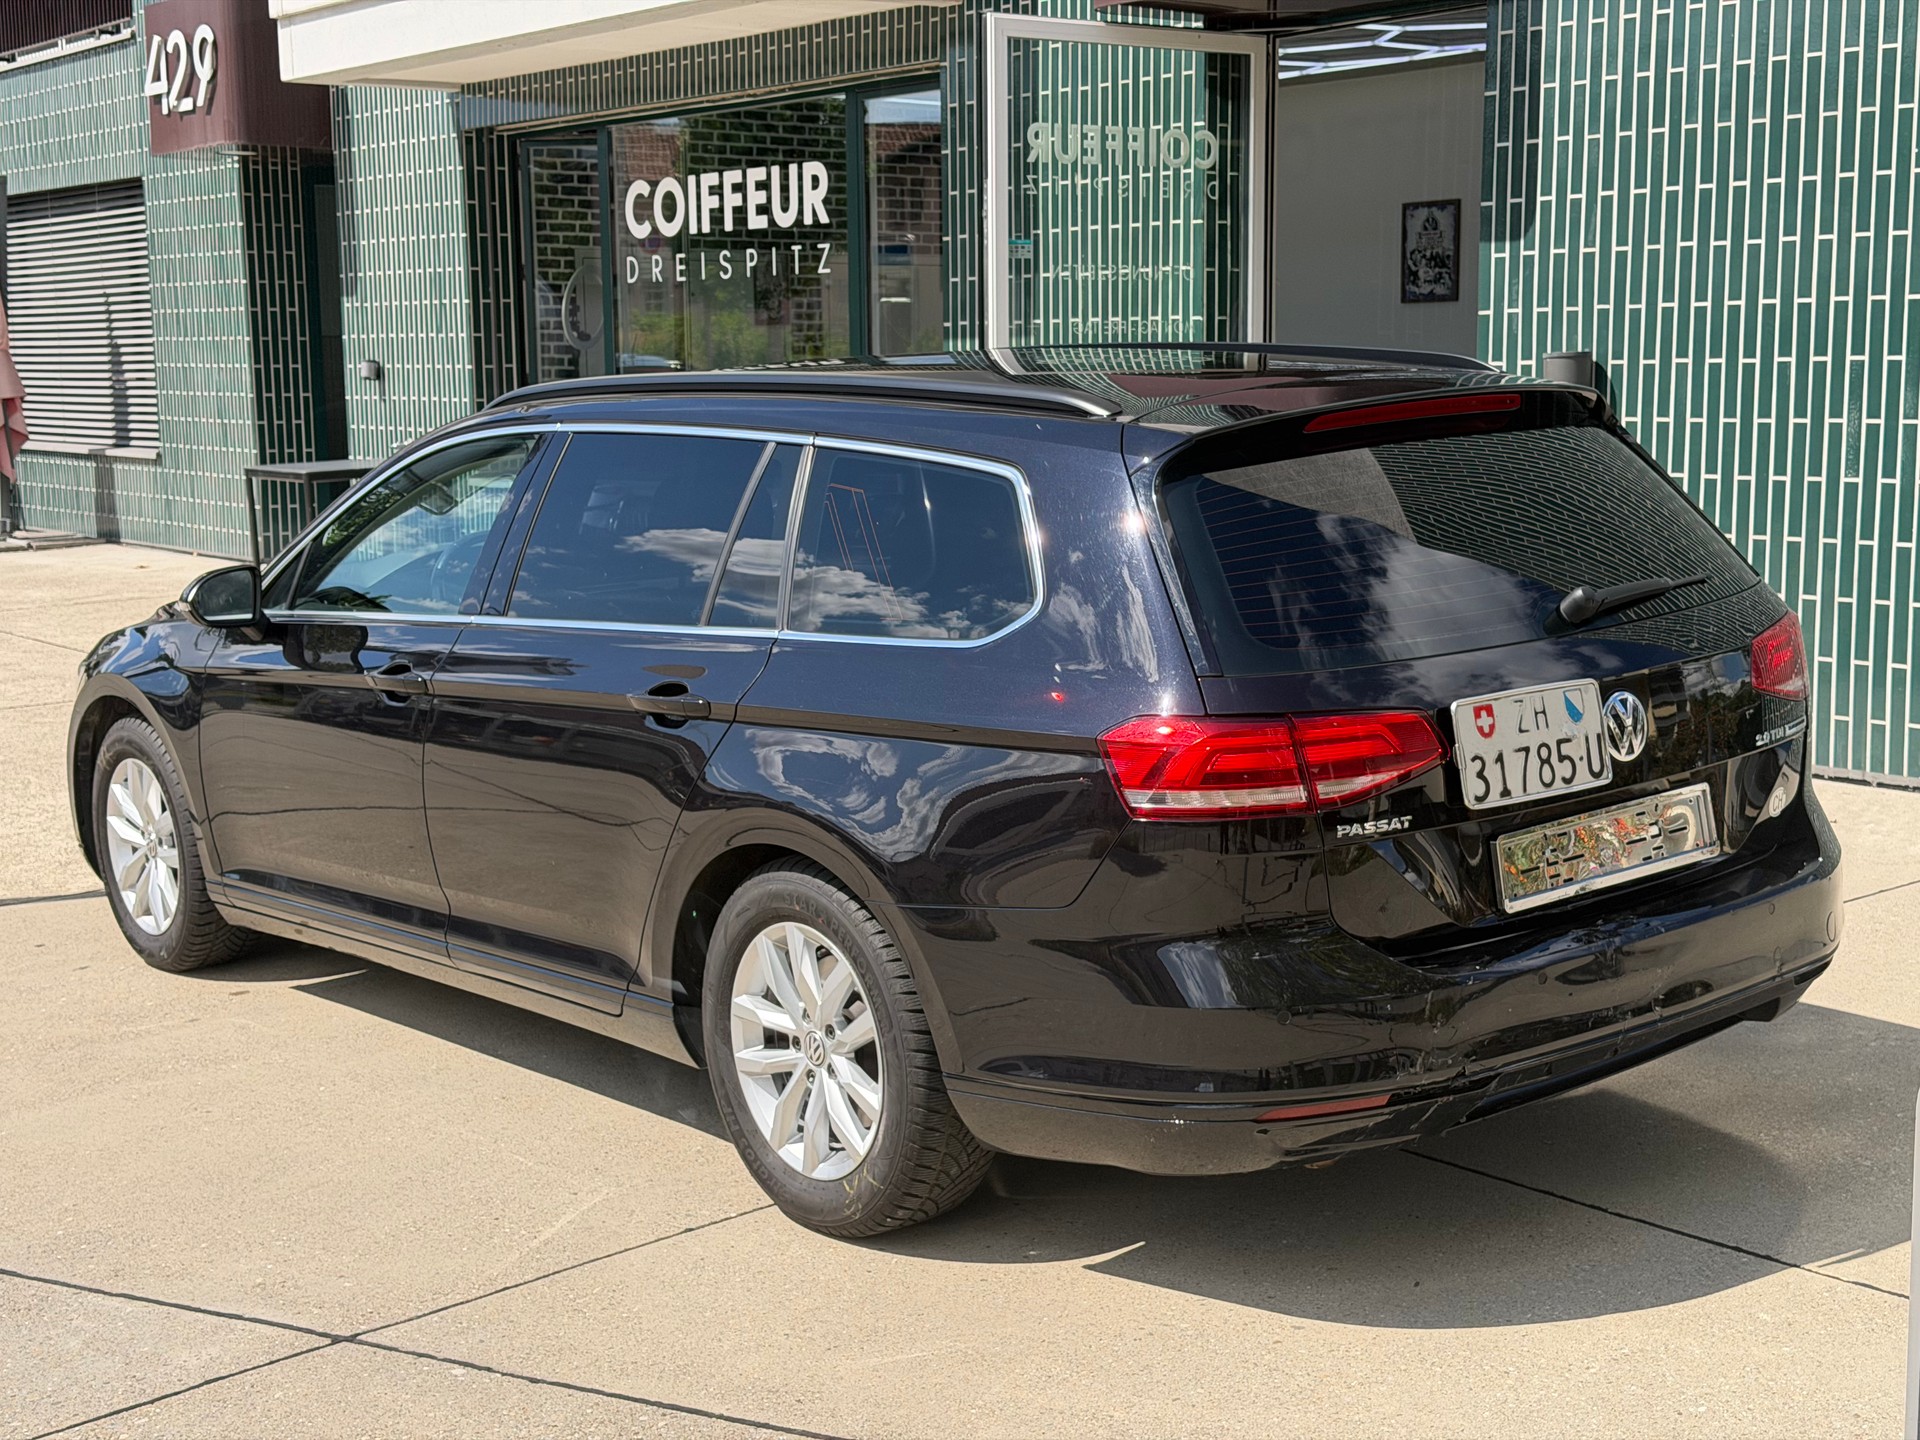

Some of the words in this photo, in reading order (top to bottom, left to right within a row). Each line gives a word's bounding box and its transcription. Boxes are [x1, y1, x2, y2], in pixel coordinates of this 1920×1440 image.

[144, 24, 214, 115] 429
[625, 161, 830, 239] COIFFEUR
[626, 243, 831, 284] DREISPITZ
[1513, 695, 1549, 733] ZH
[1337, 815, 1412, 838] PASSAT
